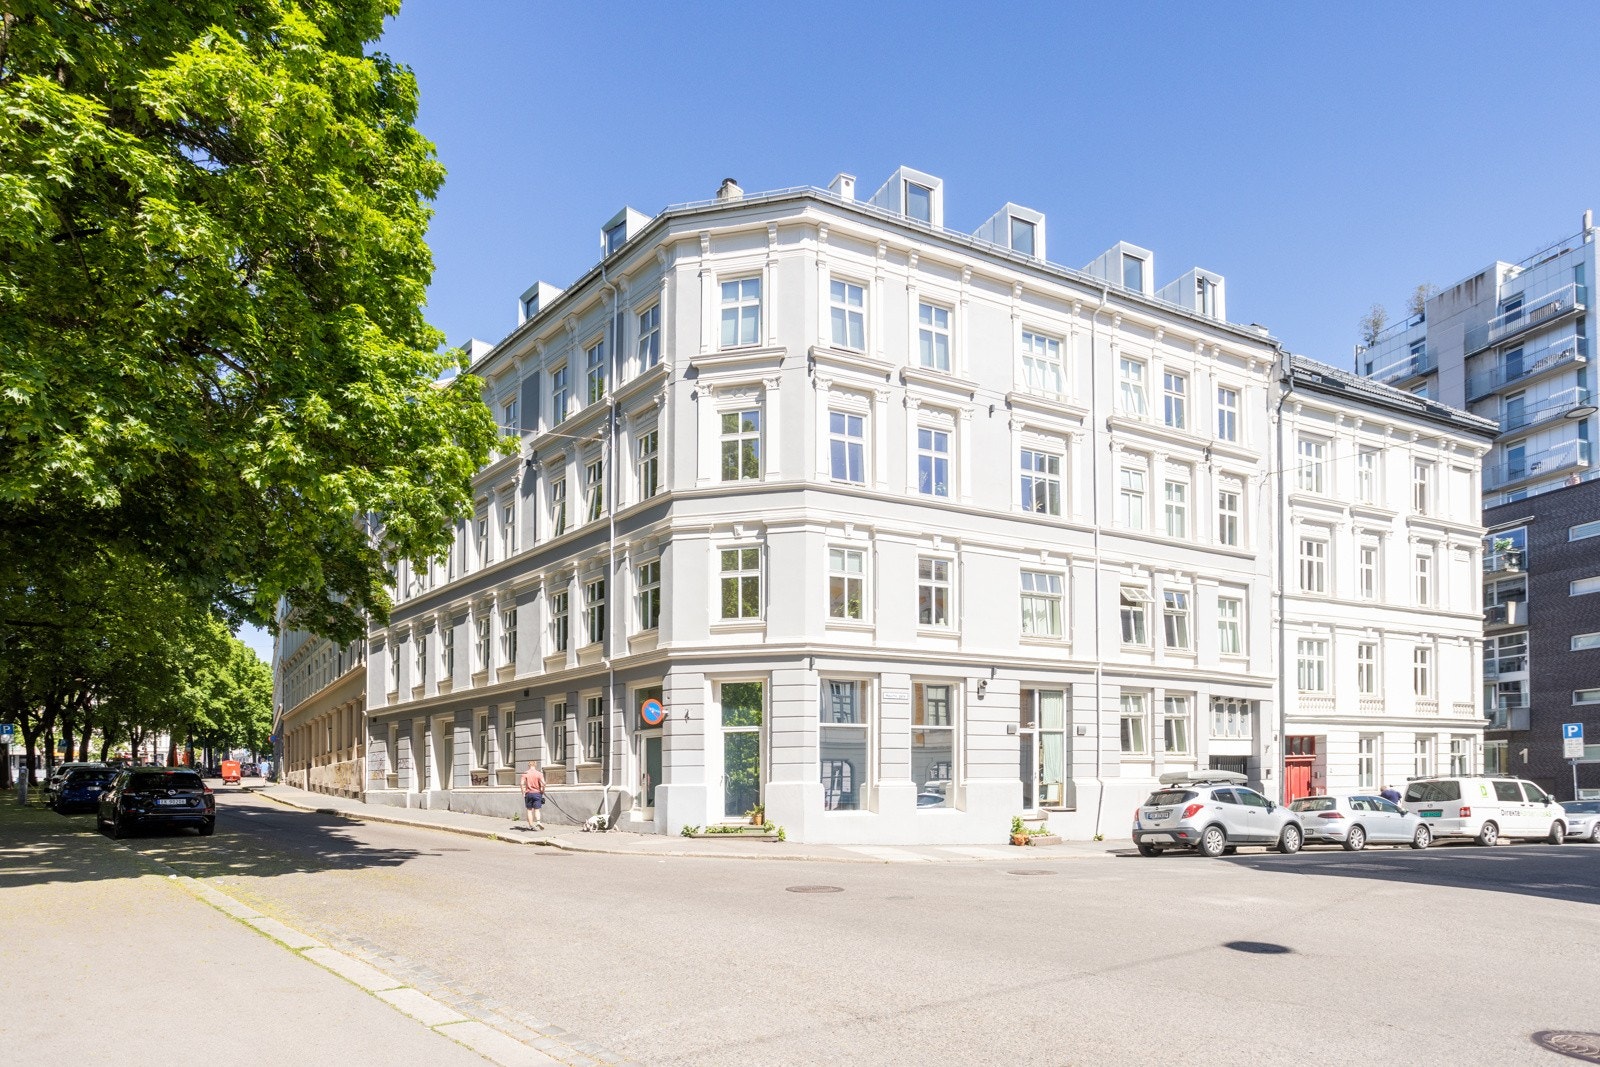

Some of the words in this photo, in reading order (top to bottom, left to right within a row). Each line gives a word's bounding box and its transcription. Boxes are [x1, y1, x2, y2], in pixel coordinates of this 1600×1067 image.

[3, 725, 11, 734] P
[1568, 725, 1579, 736] P
[1518, 748, 1529, 764] 1
